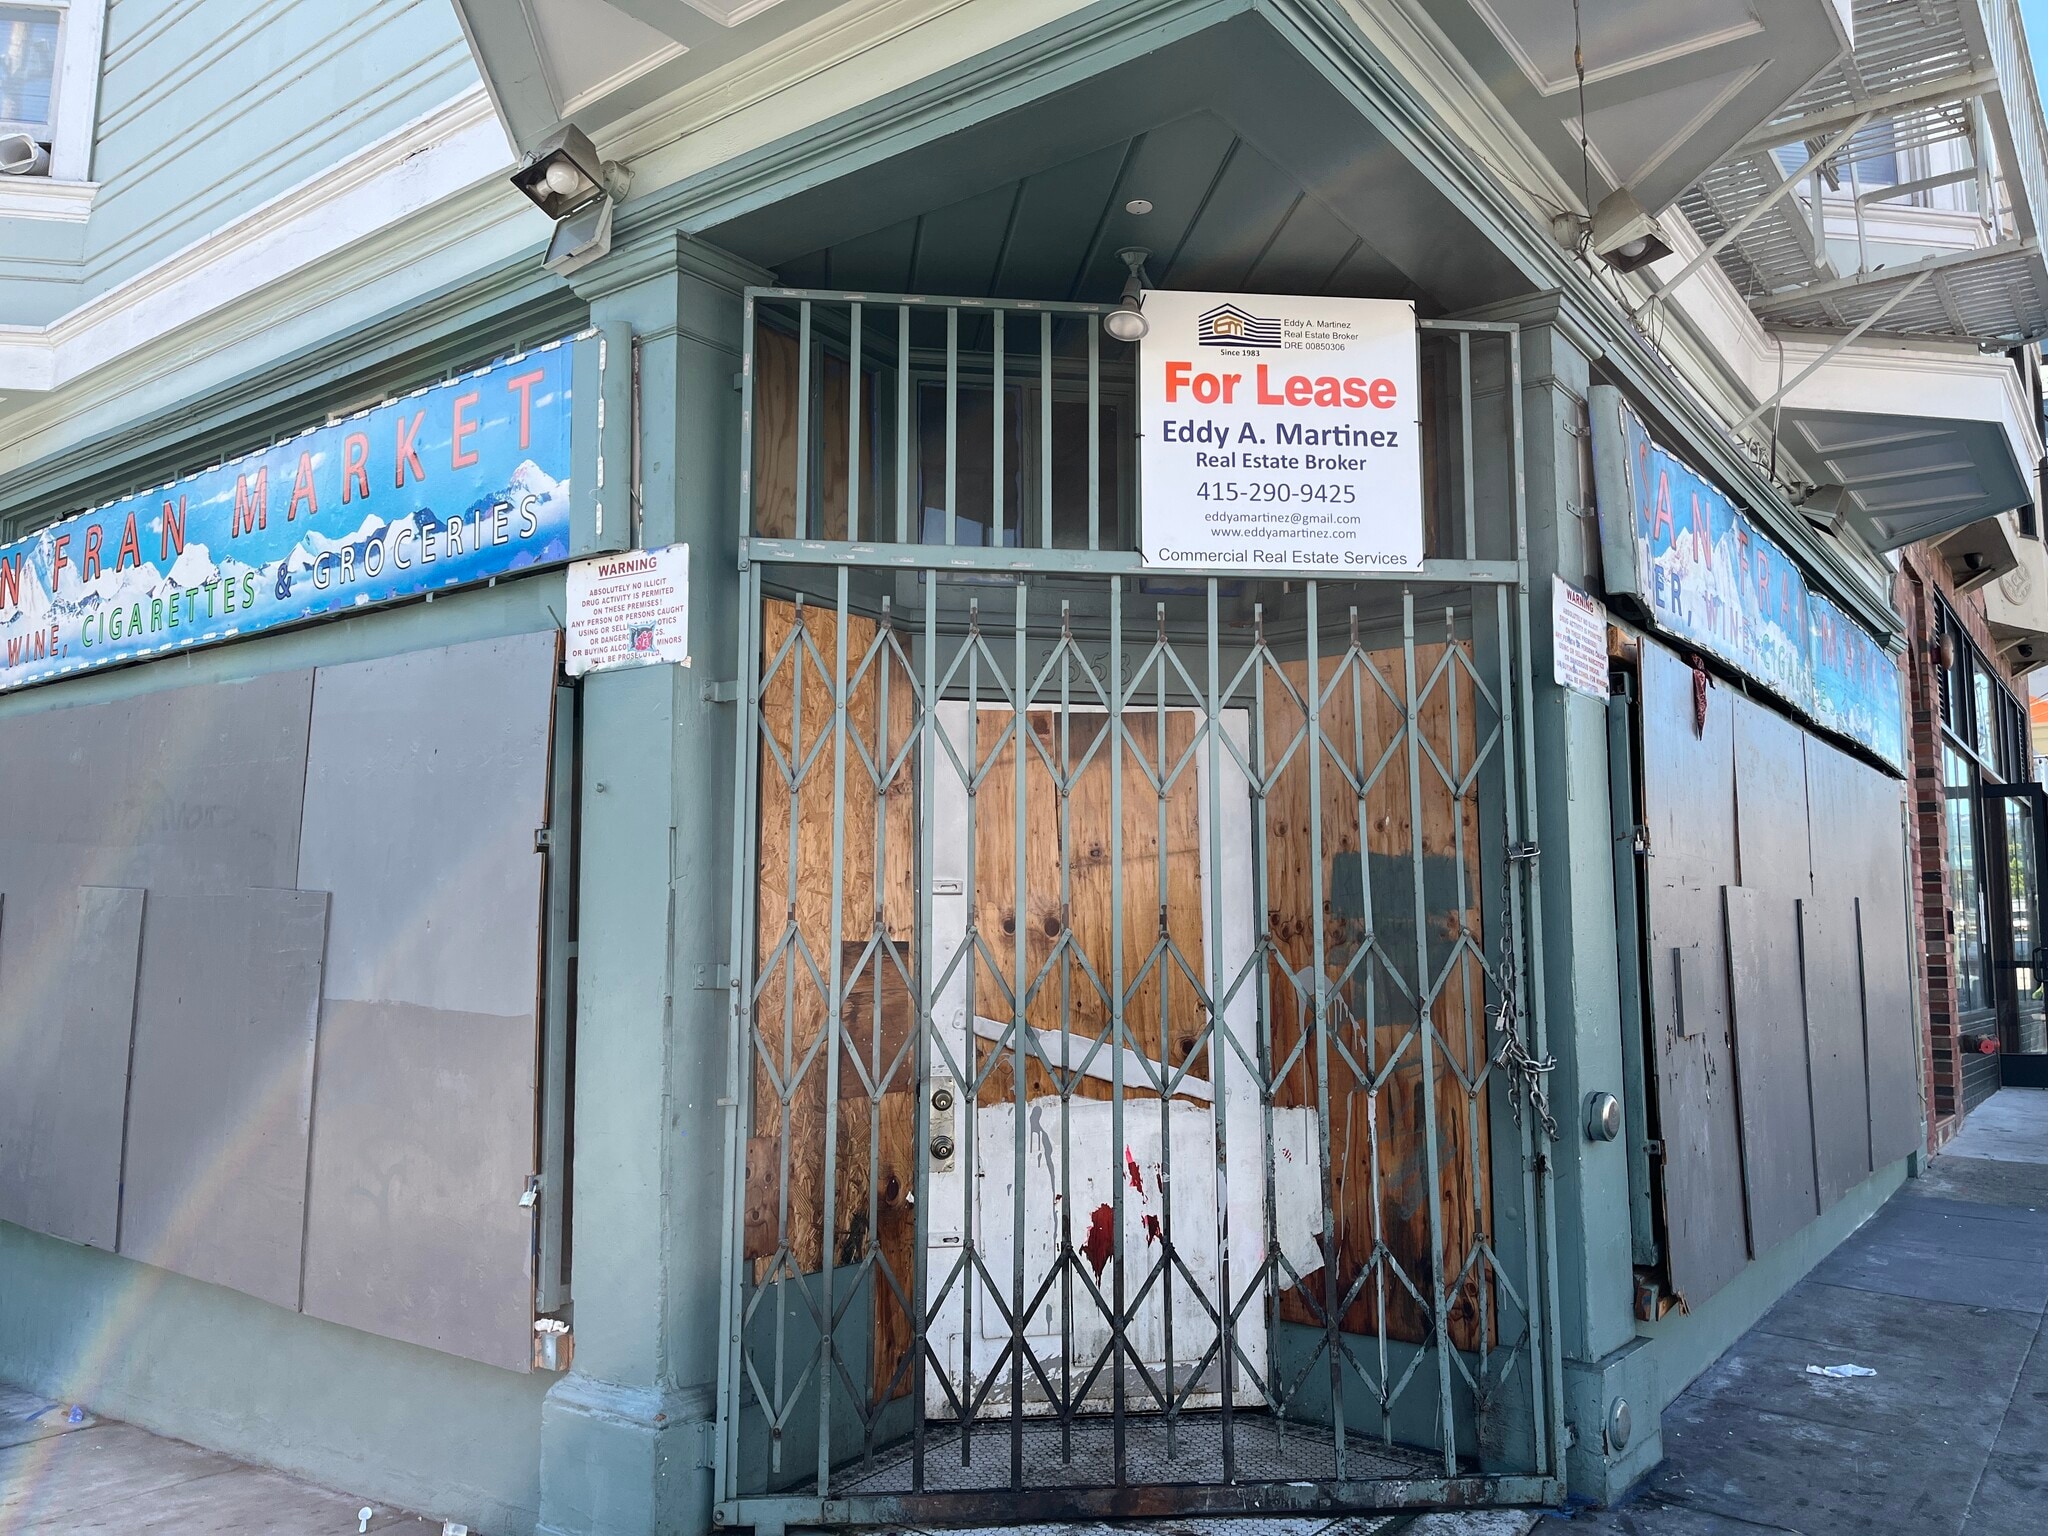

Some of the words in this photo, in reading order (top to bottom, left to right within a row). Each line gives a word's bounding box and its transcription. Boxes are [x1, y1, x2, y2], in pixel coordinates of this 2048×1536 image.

[1284, 319, 1304, 328] Eddy
[1305, 320, 1314, 328] A.
[1317, 320, 1351, 328] Martinez
[1333, 332, 1358, 340] Broker
[1220, 348, 1240, 356] Since
[1284, 342, 1302, 350] DRE
[1305, 343, 1345, 351] 00850306
[1165, 361, 1242, 404] For
[1256, 364, 1397, 410] Lease
[1163, 420, 1230, 448] Eddy
[1238, 422, 1266, 444] A.
[1276, 423, 1398, 448] Martinez
[1196, 452, 1236, 468] Real
[1242, 453, 1299, 470] Estate
[1306, 454, 1366, 470] Broker
[52, 493, 187, 594] FRAN
[232, 368, 546, 540] MARKET
[1196, 482, 1356, 503] 415-290-9425
[1640, 442, 1712, 572] SAN
[1204, 512, 1360, 525] eddyamartinez@gmail.com
[1211, 523, 1356, 539] www.eddyamartinez.com
[1158, 548, 1248, 564] Commercial
[1253, 550, 1287, 564] Real
[1292, 550, 1339, 564] Estate
[1344, 551, 1408, 565] Services
[598, 557, 657, 577] WARNING
[7, 624, 68, 668] WINE,
[81, 571, 256, 649] CIGARETTES
[274, 562, 292, 601] &
[313, 495, 538, 590] GROCERIES
[590, 584, 630, 596] ABSOLUTELY
[632, 582, 642, 590] NO
[644, 578, 666, 588] ILLICIT
[582, 598, 600, 608] DRUG
[602, 594, 632, 604] ACTIVITY
[642, 587, 674, 598] PERMITED
[1566, 588, 1594, 612] WARNING
[572, 620, 584, 628] ANY
[587, 616, 612, 626] PERSON
[614, 614, 624, 622] OR
[626, 610, 655, 620] PERSONS
[658, 605, 684, 616] CAUGHT
[594, 608, 602, 616] ON
[605, 604, 625, 614] THESE
[578, 627, 598, 637] USING
[590, 638, 598, 646] OR
[600, 634, 630, 643] DANGERO
[584, 646, 608, 656] BUYING
[610, 644, 627, 652] ALCO
[656, 636, 682, 646] MINORS
